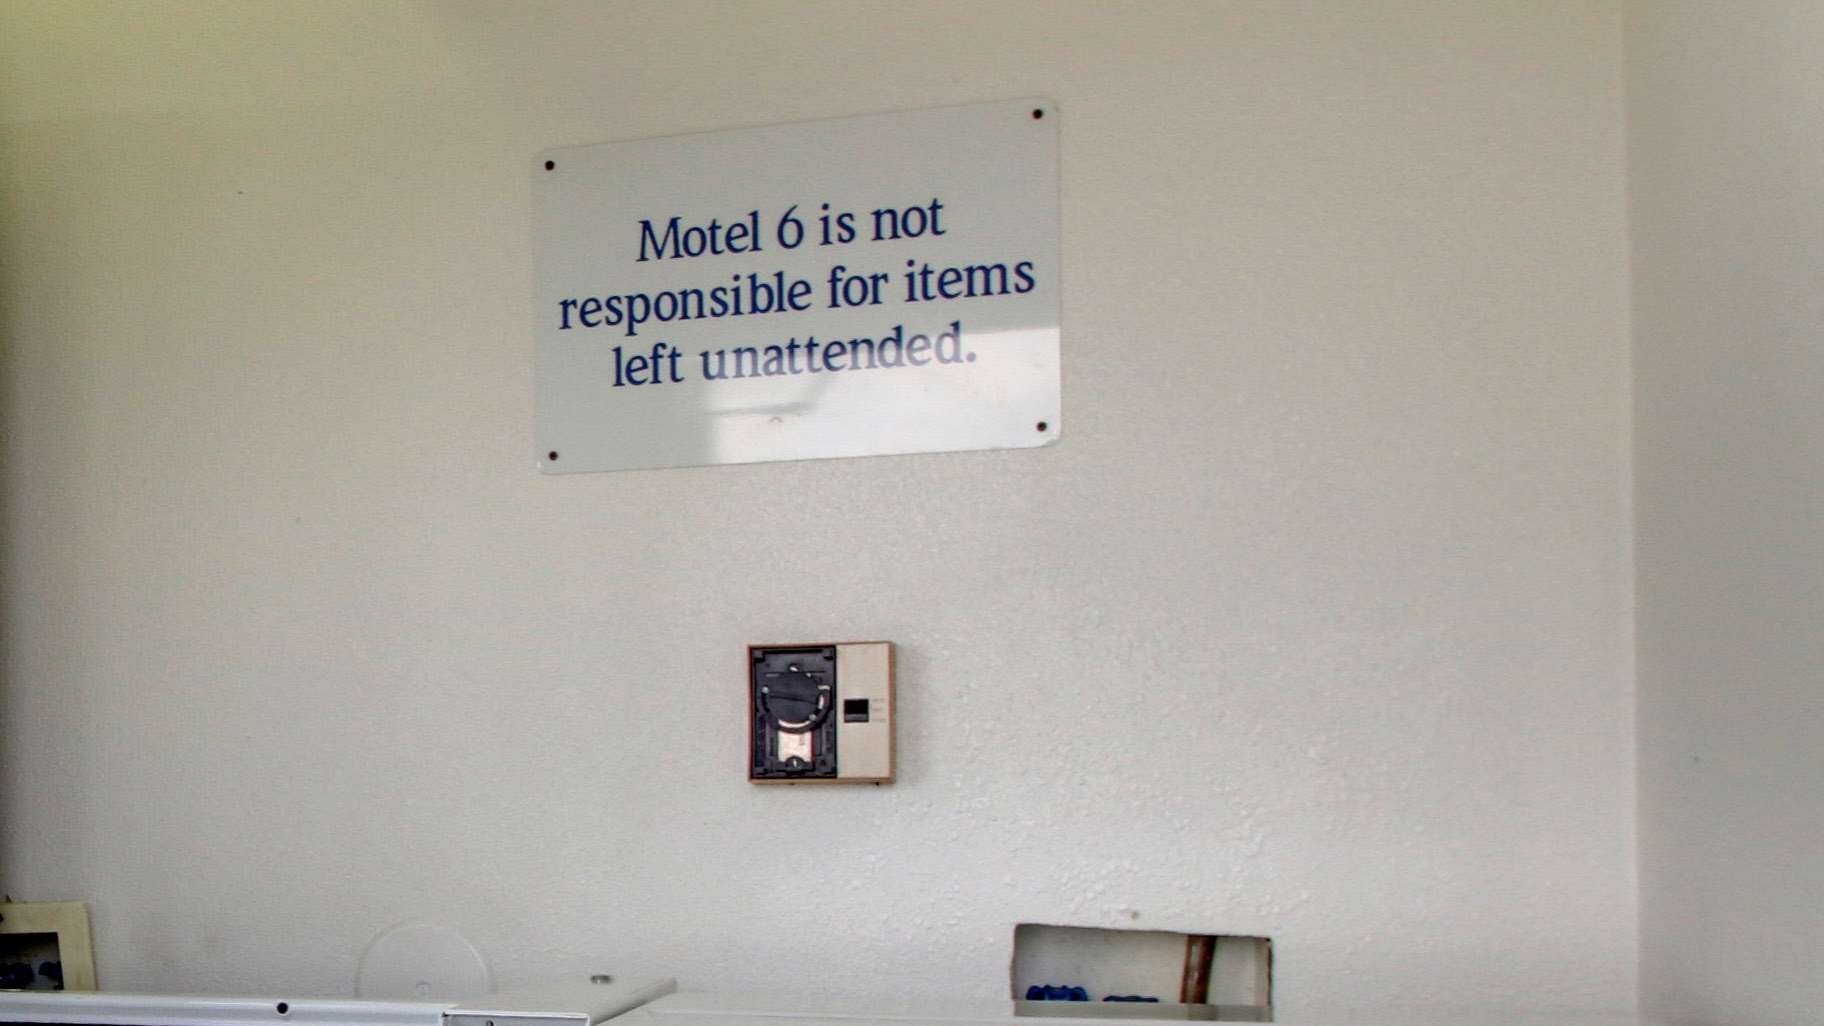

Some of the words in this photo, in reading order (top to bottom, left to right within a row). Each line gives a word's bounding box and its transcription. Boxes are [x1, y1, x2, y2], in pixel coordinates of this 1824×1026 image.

[636, 210, 763, 261] Motel
[777, 205, 805, 249] 6
[819, 203, 856, 245] is
[871, 197, 946, 241] not
[558, 270, 812, 336] responsible
[827, 266, 889, 307] for
[904, 258, 1036, 302] items
[611, 344, 685, 386] left
[700, 321, 978, 380] unattended.
